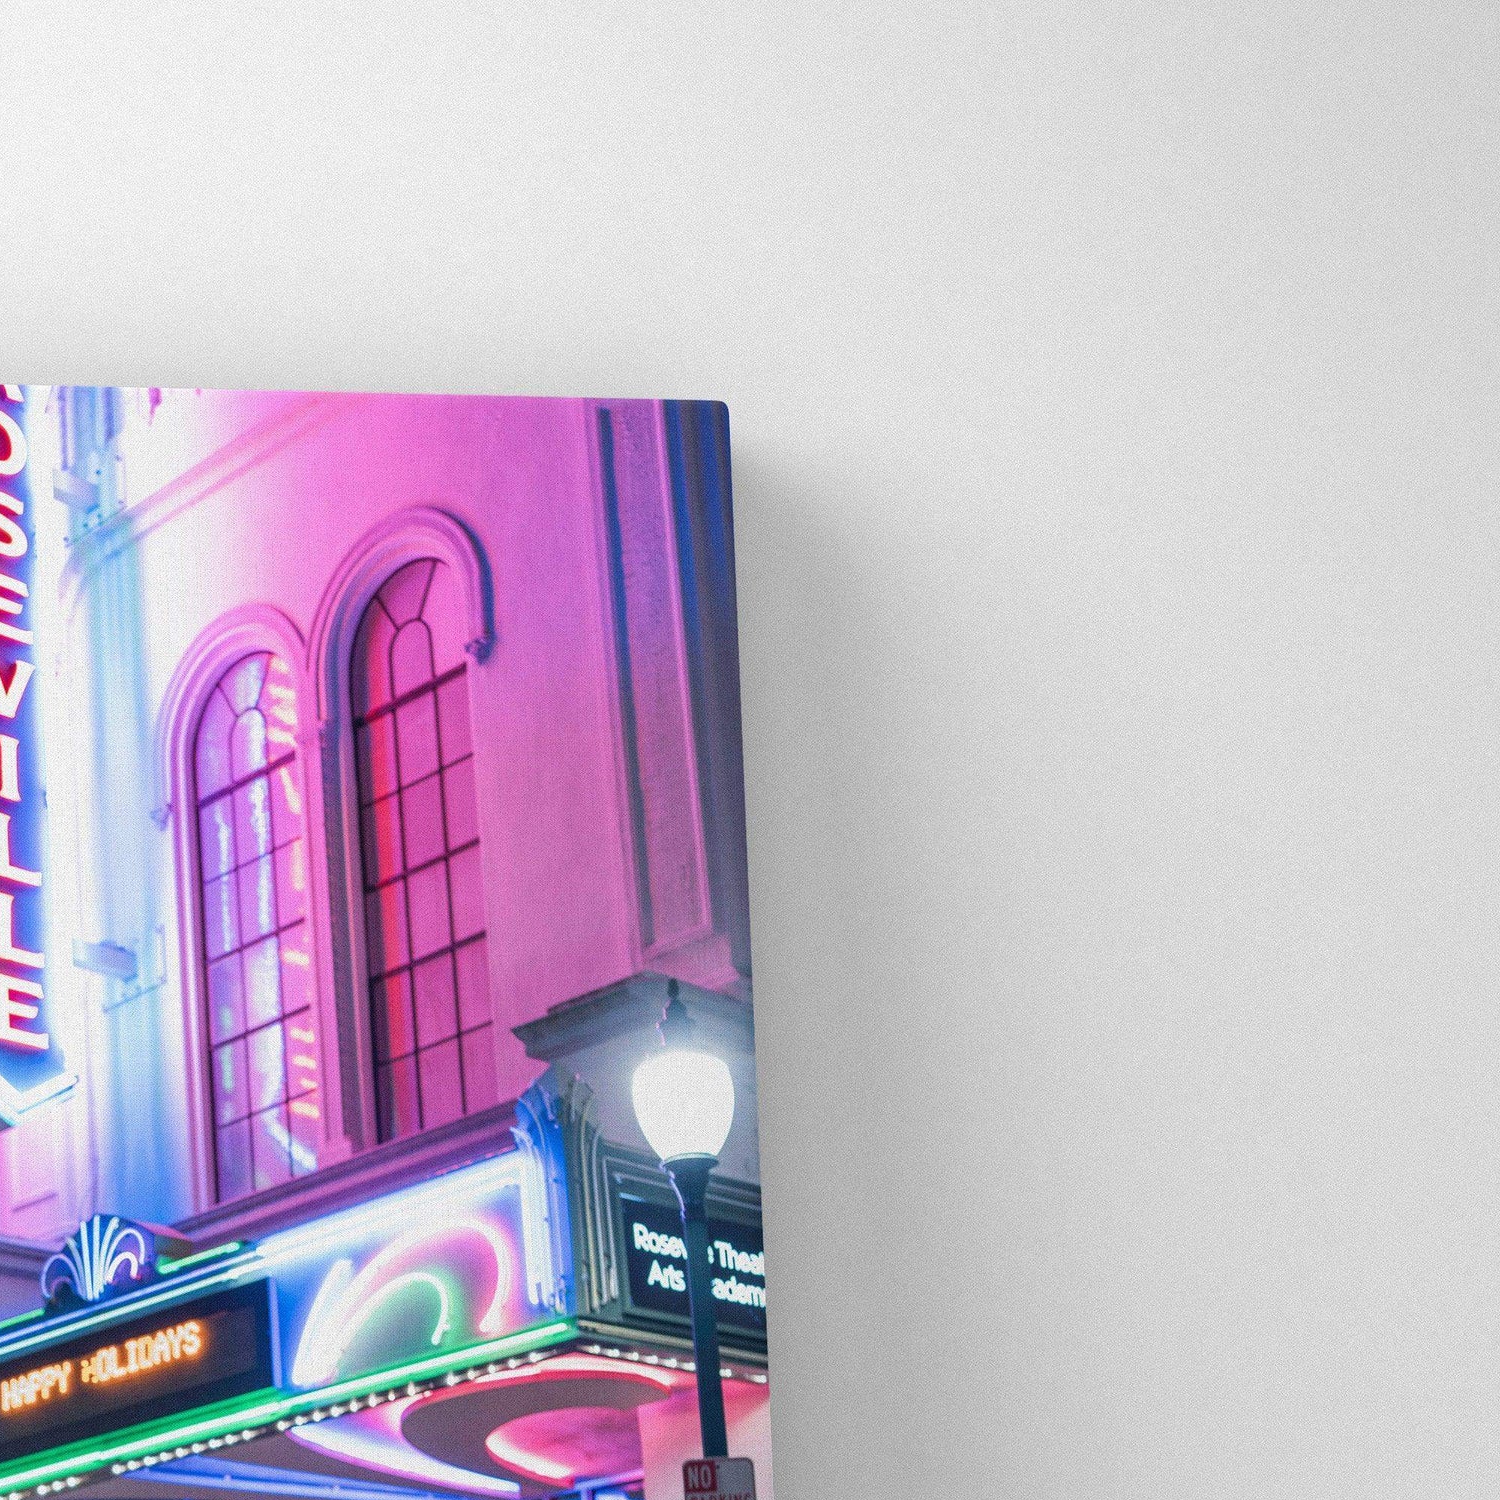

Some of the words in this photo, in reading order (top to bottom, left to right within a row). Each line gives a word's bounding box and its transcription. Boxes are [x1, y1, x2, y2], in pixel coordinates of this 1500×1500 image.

[647, 1259, 686, 1292] Arts
[0, 1361, 72, 1412] HAPPY
[687, 1464, 713, 1490] NO
